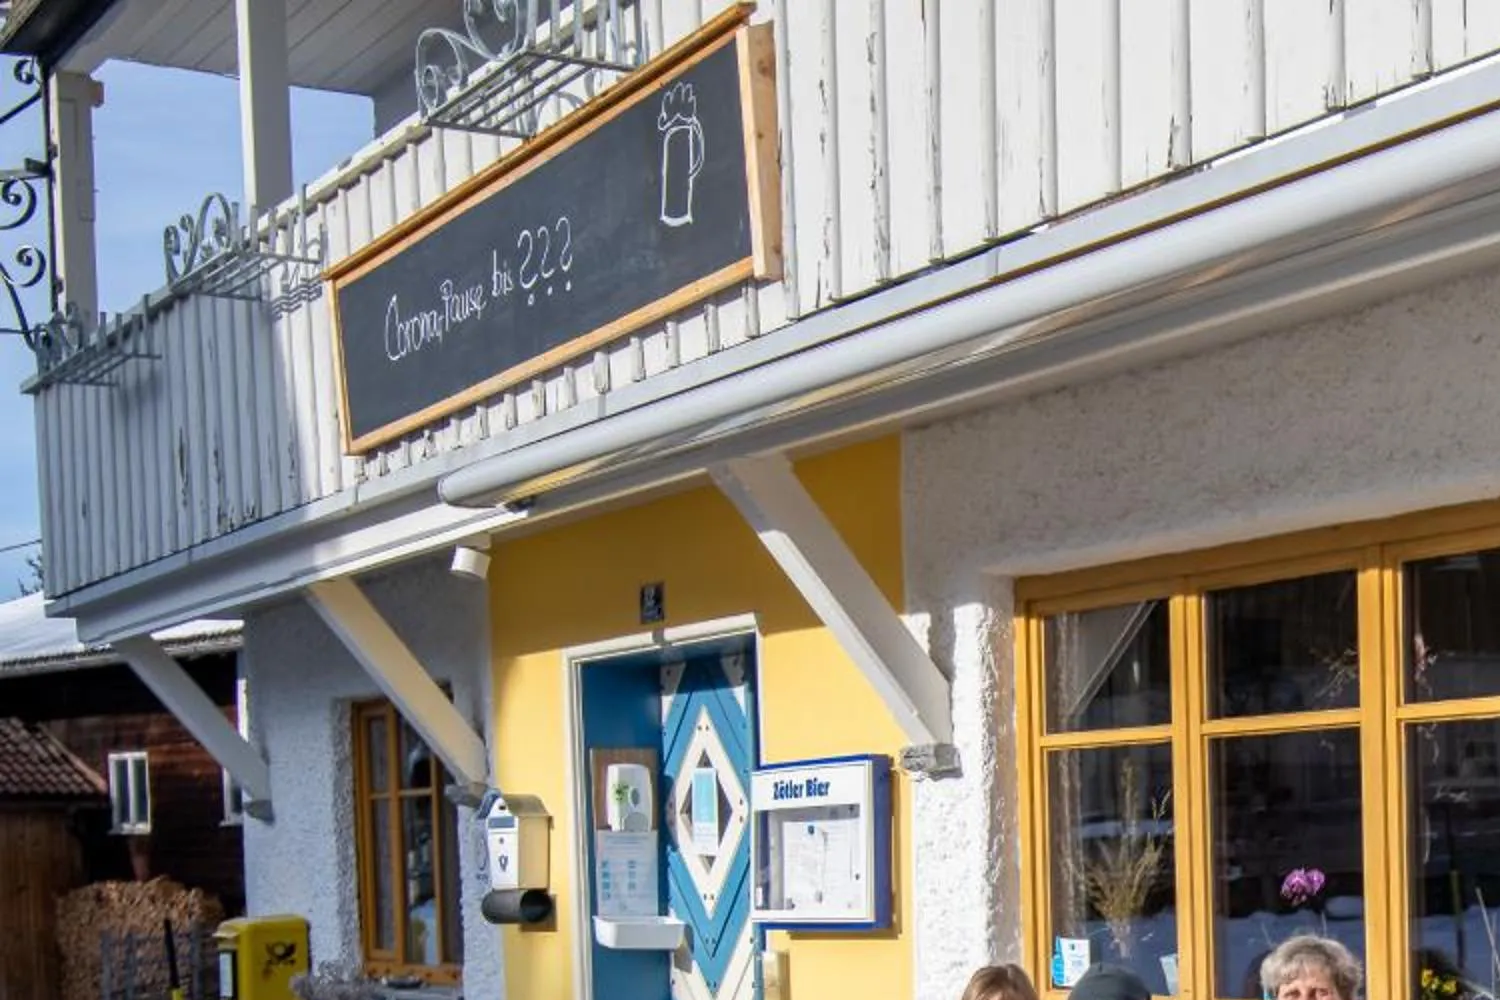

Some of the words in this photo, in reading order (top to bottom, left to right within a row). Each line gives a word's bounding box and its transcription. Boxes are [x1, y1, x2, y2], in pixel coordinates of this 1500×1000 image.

[491, 249, 514, 297] bis
[517, 216, 573, 306] ???
[806, 777, 831, 798] Bier
